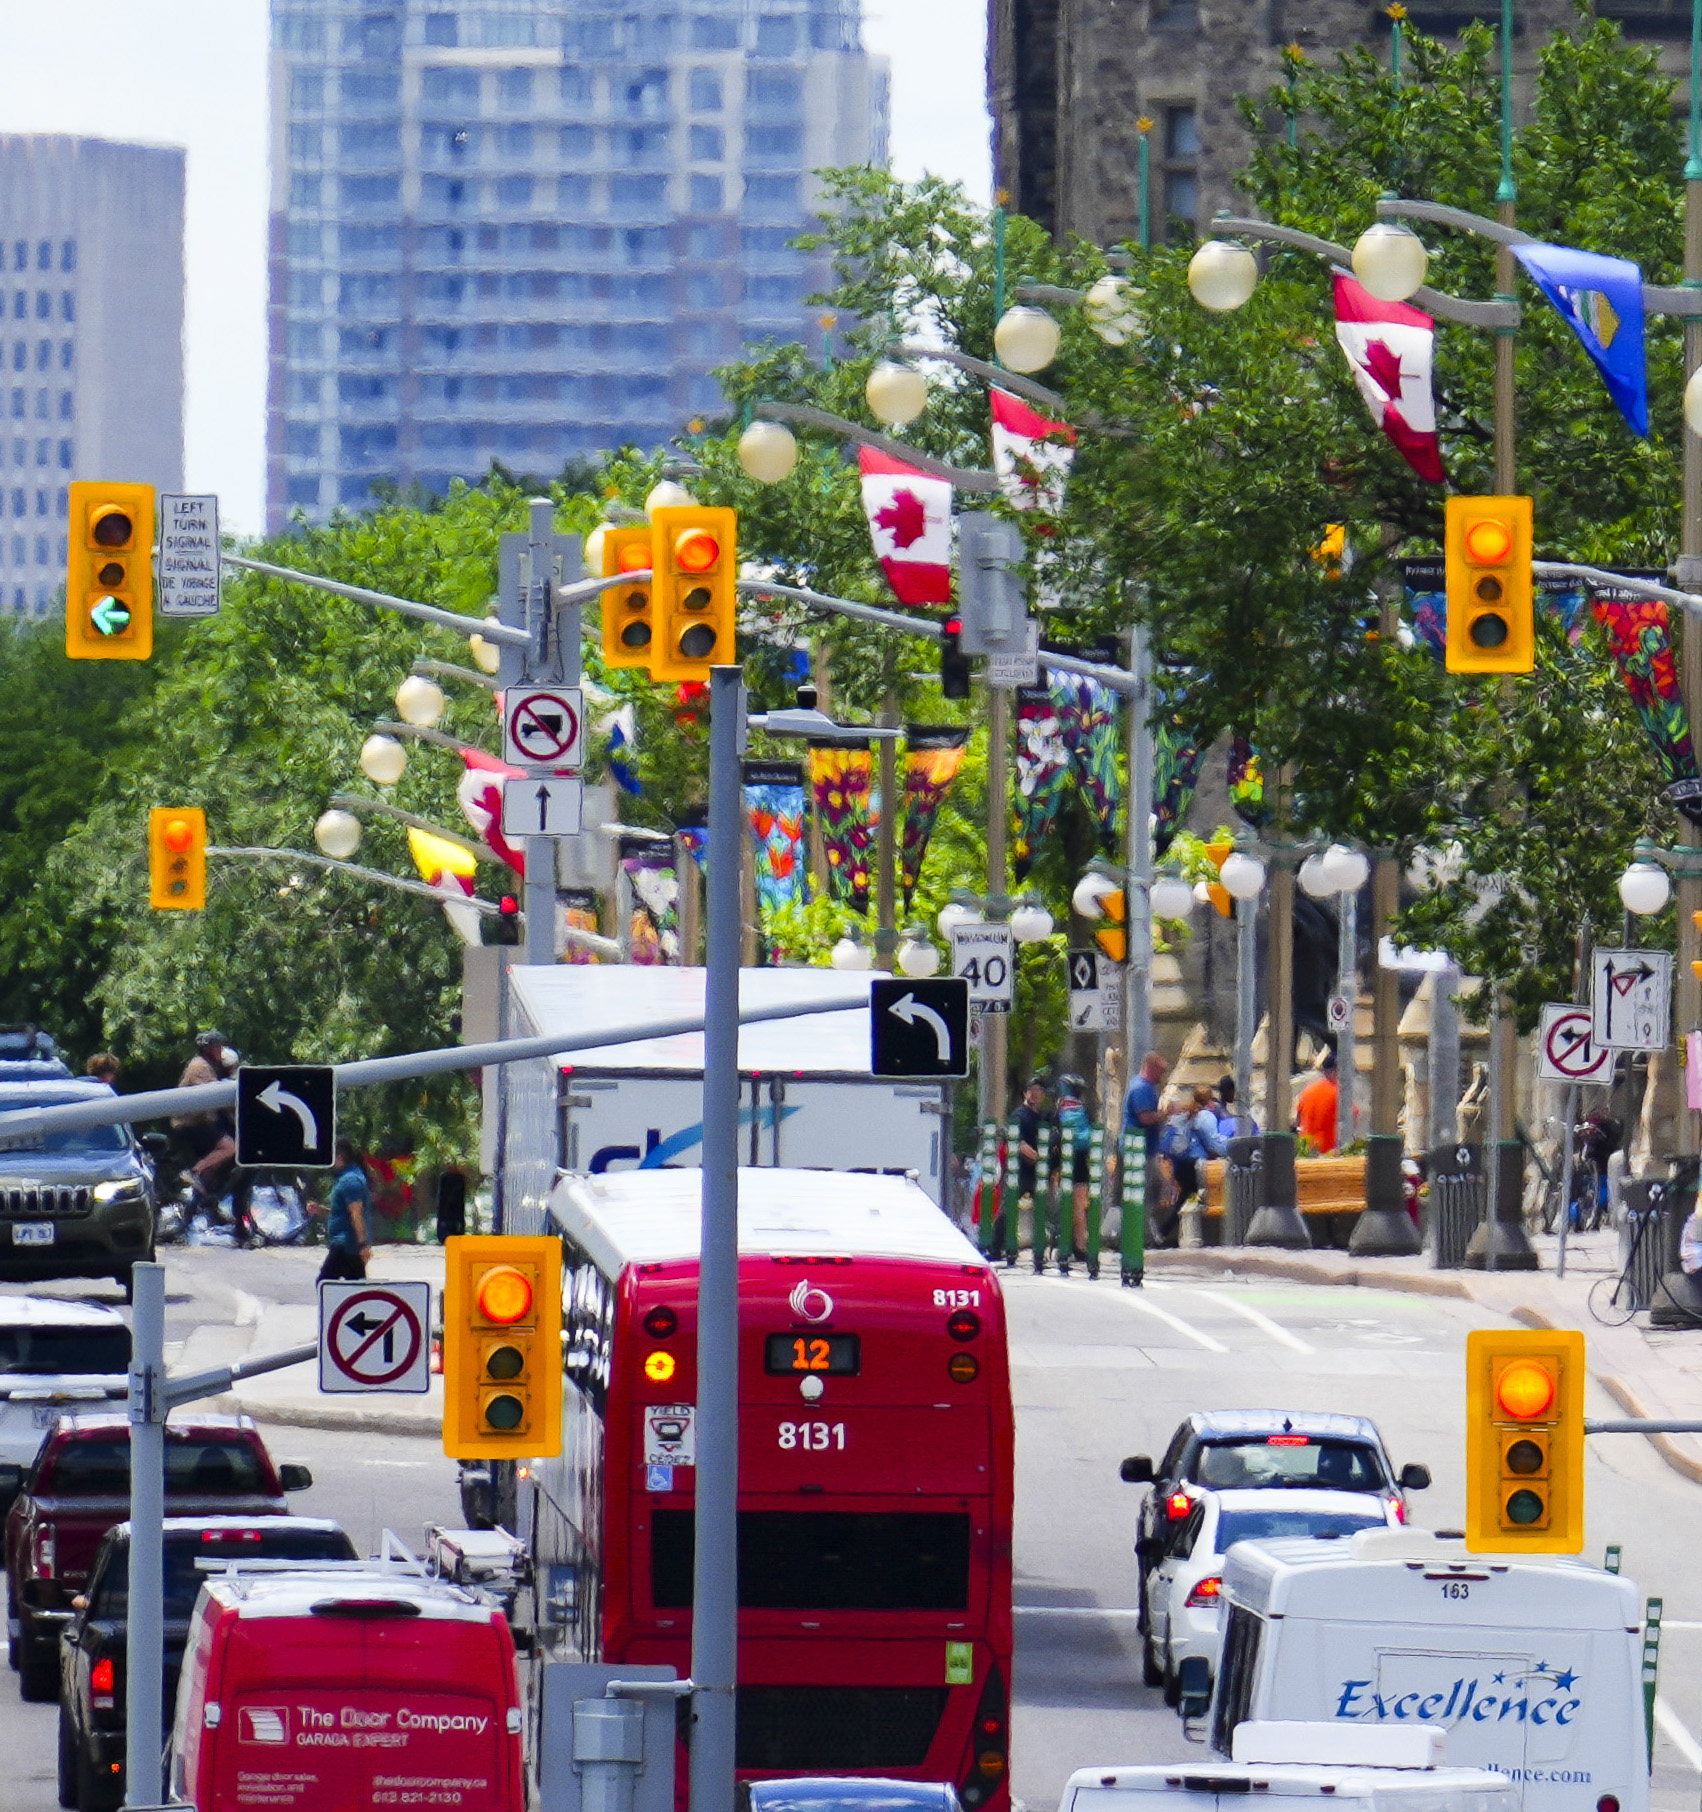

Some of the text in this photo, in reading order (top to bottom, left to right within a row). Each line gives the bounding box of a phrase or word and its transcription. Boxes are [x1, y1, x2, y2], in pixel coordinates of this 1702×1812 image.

[174, 502, 204, 514] LEFT
[173, 519, 206, 531] TURN
[959, 956, 1006, 987] 40
[933, 1289, 980, 1307] 8131
[792, 1338, 830, 1370] 12
[778, 1422, 846, 1451] 8131
[1441, 1583, 1469, 1600] 163
[1335, 1678, 1581, 1726] Excellence
[297, 1706, 489, 1735] The Door Company
